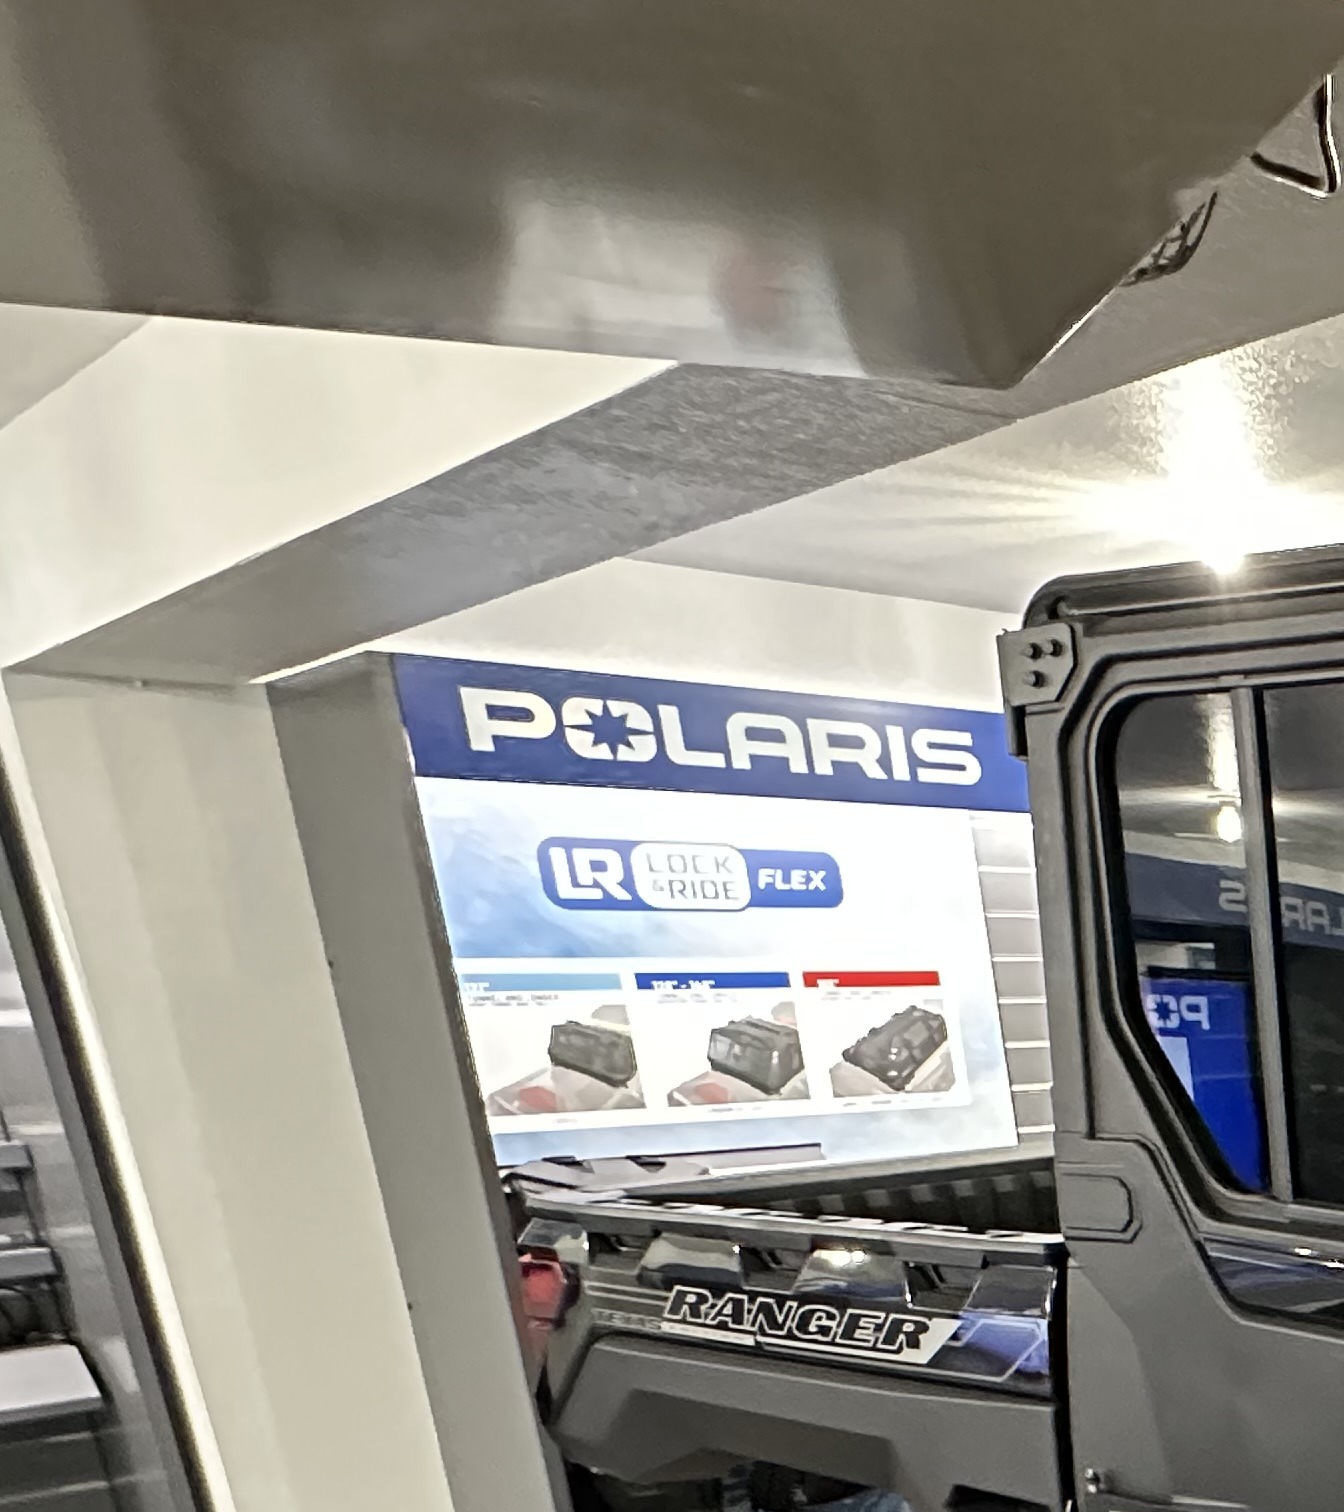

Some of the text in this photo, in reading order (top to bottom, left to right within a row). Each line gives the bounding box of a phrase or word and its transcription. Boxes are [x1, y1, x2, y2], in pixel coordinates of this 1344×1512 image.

[459, 687, 982, 786] POLARIS
[549, 847, 632, 901] LR
[646, 853, 735, 875] LOCK
[758, 868, 826, 892] FLEX
[663, 1284, 932, 1351] RANGER
